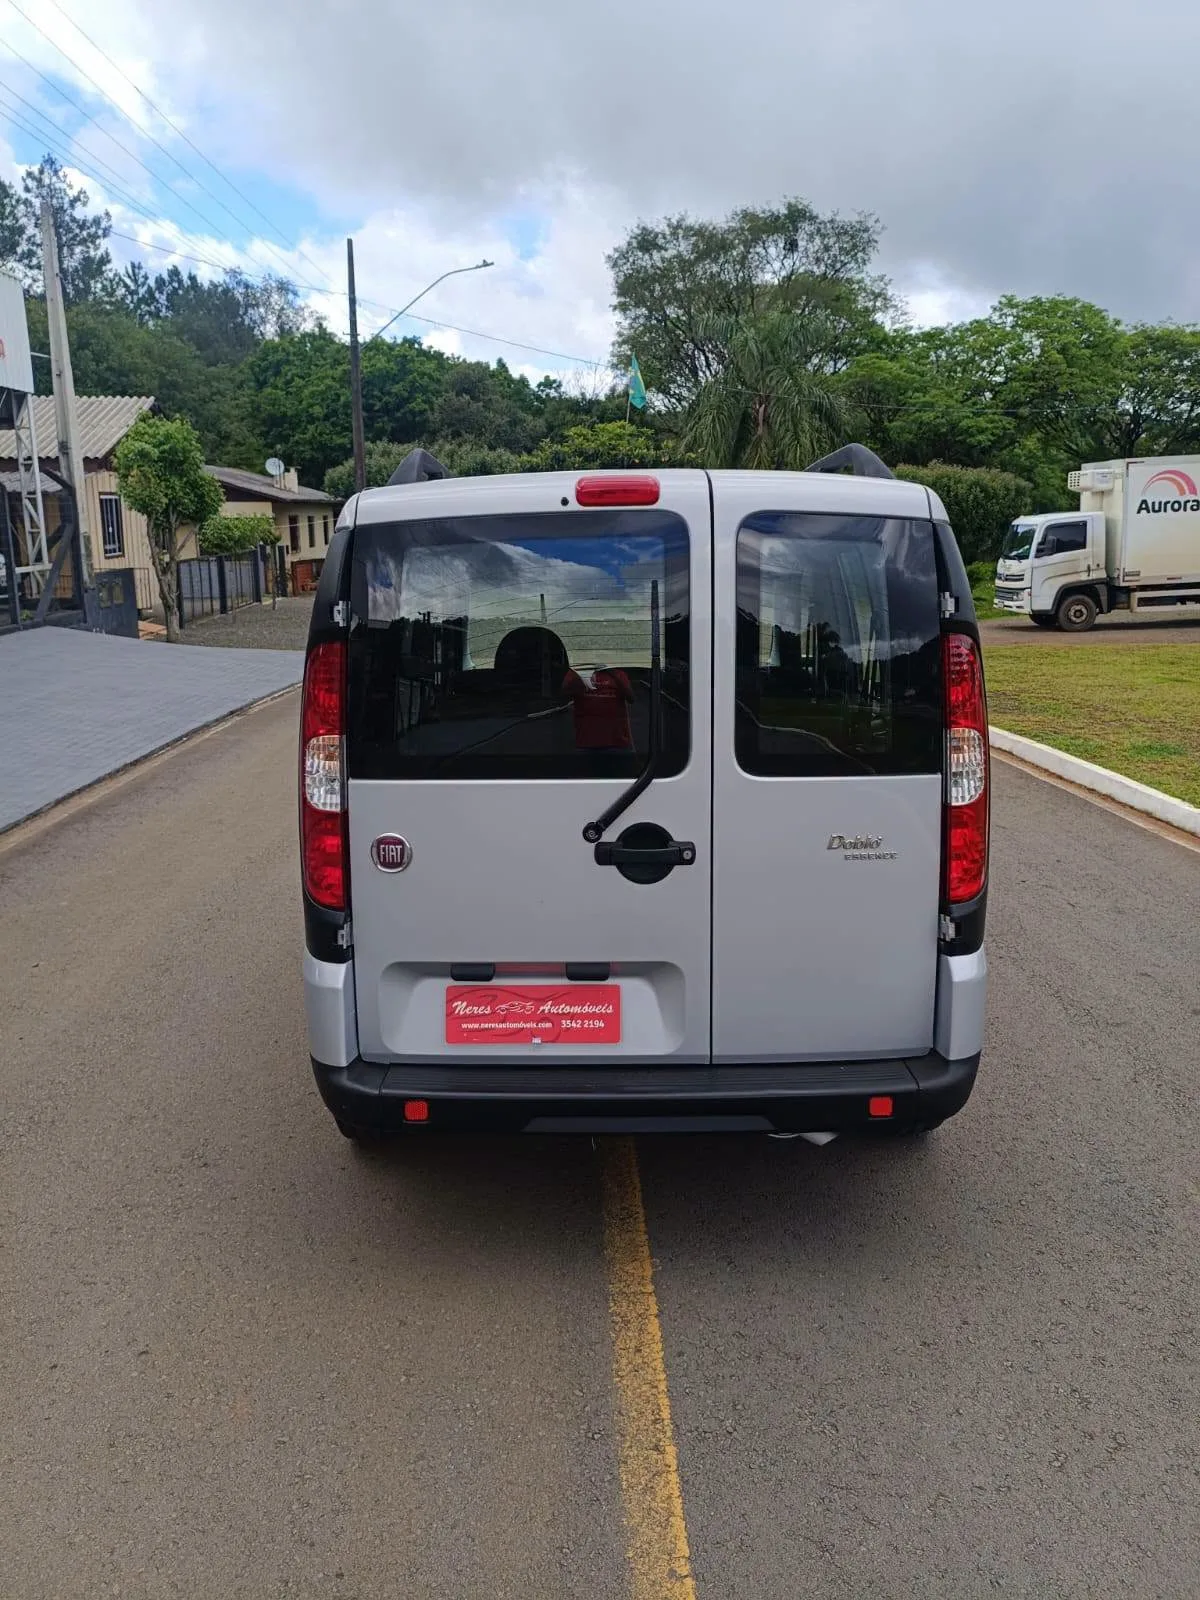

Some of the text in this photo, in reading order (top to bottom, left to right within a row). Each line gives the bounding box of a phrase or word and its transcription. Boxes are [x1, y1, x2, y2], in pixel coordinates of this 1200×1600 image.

[1136, 499, 1200, 515] Aurora
[380, 845, 402, 863] FIAT
[844, 852, 897, 861] ESSENCE
[452, 1001, 613, 1015] Neres Automóveis
[561, 1019, 582, 1028] 3542
